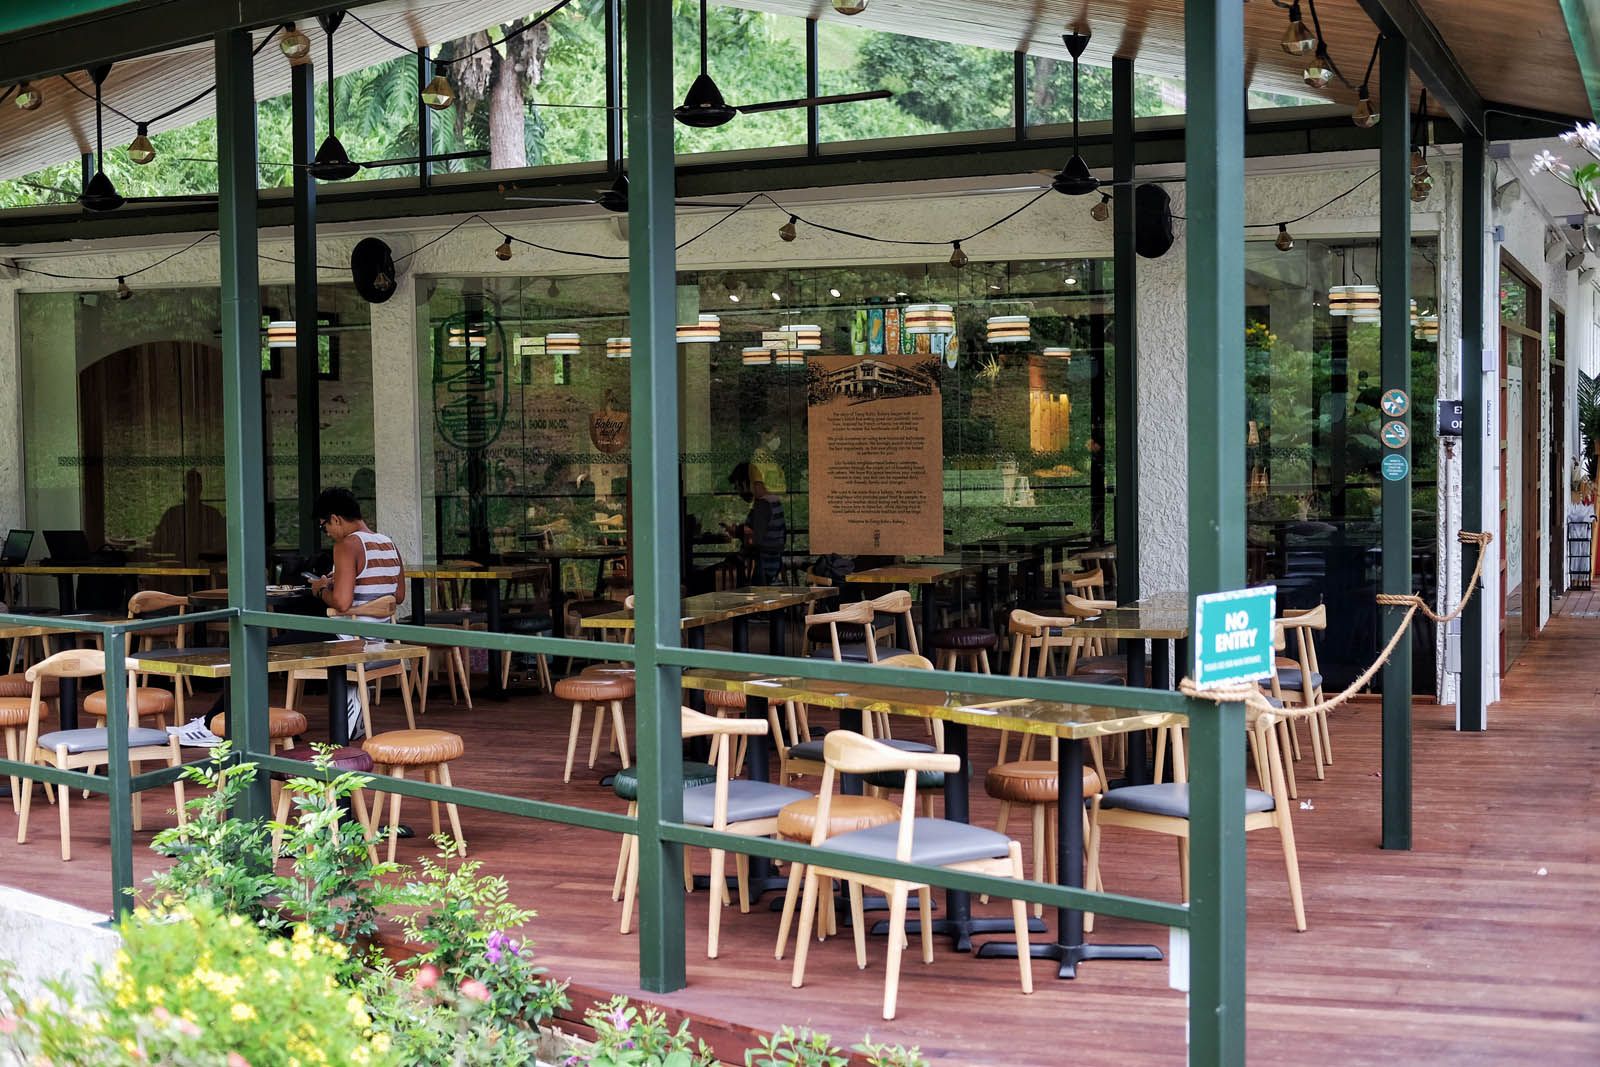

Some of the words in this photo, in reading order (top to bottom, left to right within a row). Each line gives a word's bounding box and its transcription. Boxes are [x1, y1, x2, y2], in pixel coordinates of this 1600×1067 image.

[595, 416, 624, 433] Baking
[1451, 420, 1462, 429] O
[1225, 610, 1249, 632] NO
[1215, 628, 1258, 653] ENTRY
